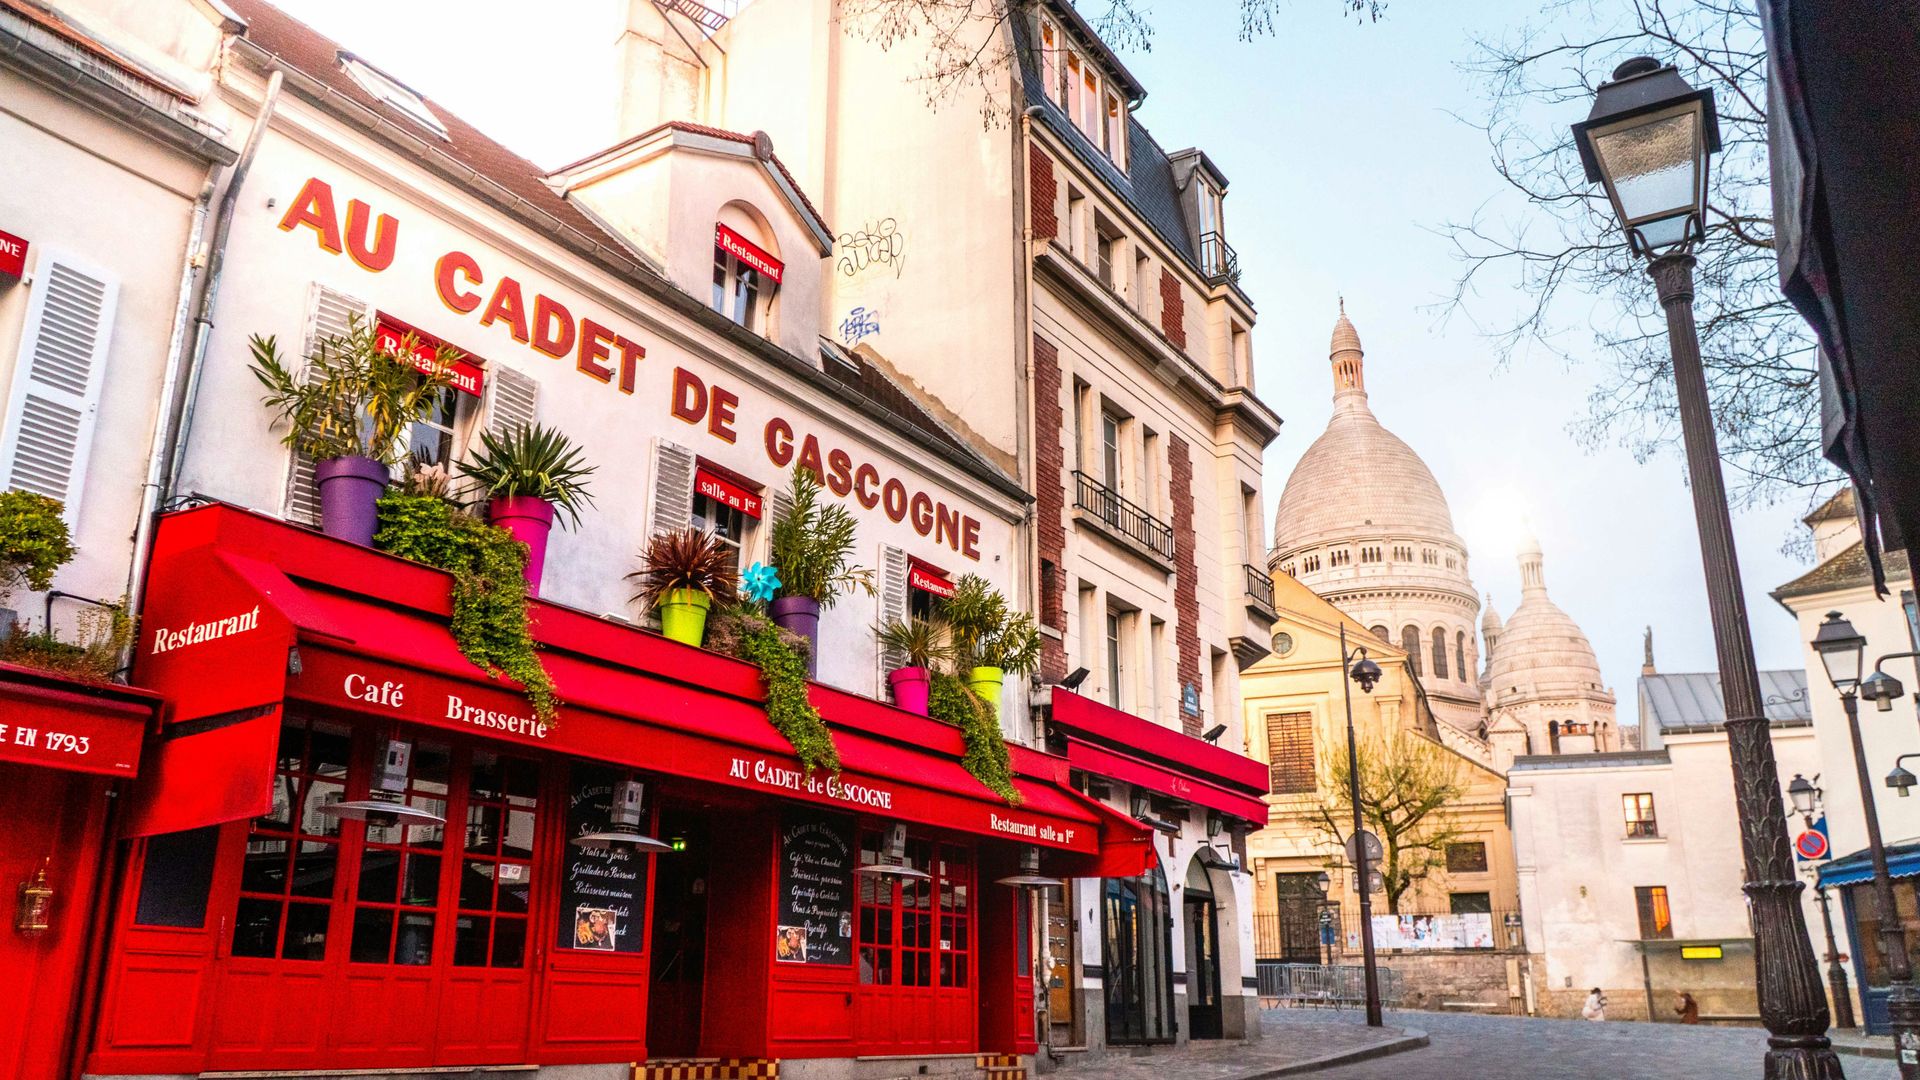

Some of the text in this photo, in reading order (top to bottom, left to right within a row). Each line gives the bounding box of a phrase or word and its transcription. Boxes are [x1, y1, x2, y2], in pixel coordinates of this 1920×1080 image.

[723, 232, 780, 280] Restaurant
[277, 177, 981, 561] AU CADET DE GASCOGNE
[701, 481, 757, 511] salle au 1er
[151, 605, 260, 655] Restaurant
[344, 673, 548, 739] Café Brasserie
[14, 726, 38, 747] EN
[45, 731, 90, 755] 1793
[729, 758, 750, 780] AU
[754, 759, 802, 791] CADET
[807, 776, 824, 795] de
[990, 813, 1074, 844] Restaurant salle au 1er
[570, 862, 604, 880] Grillades
[606, 853, 630, 864] jour
[609, 888, 633, 899] maison
